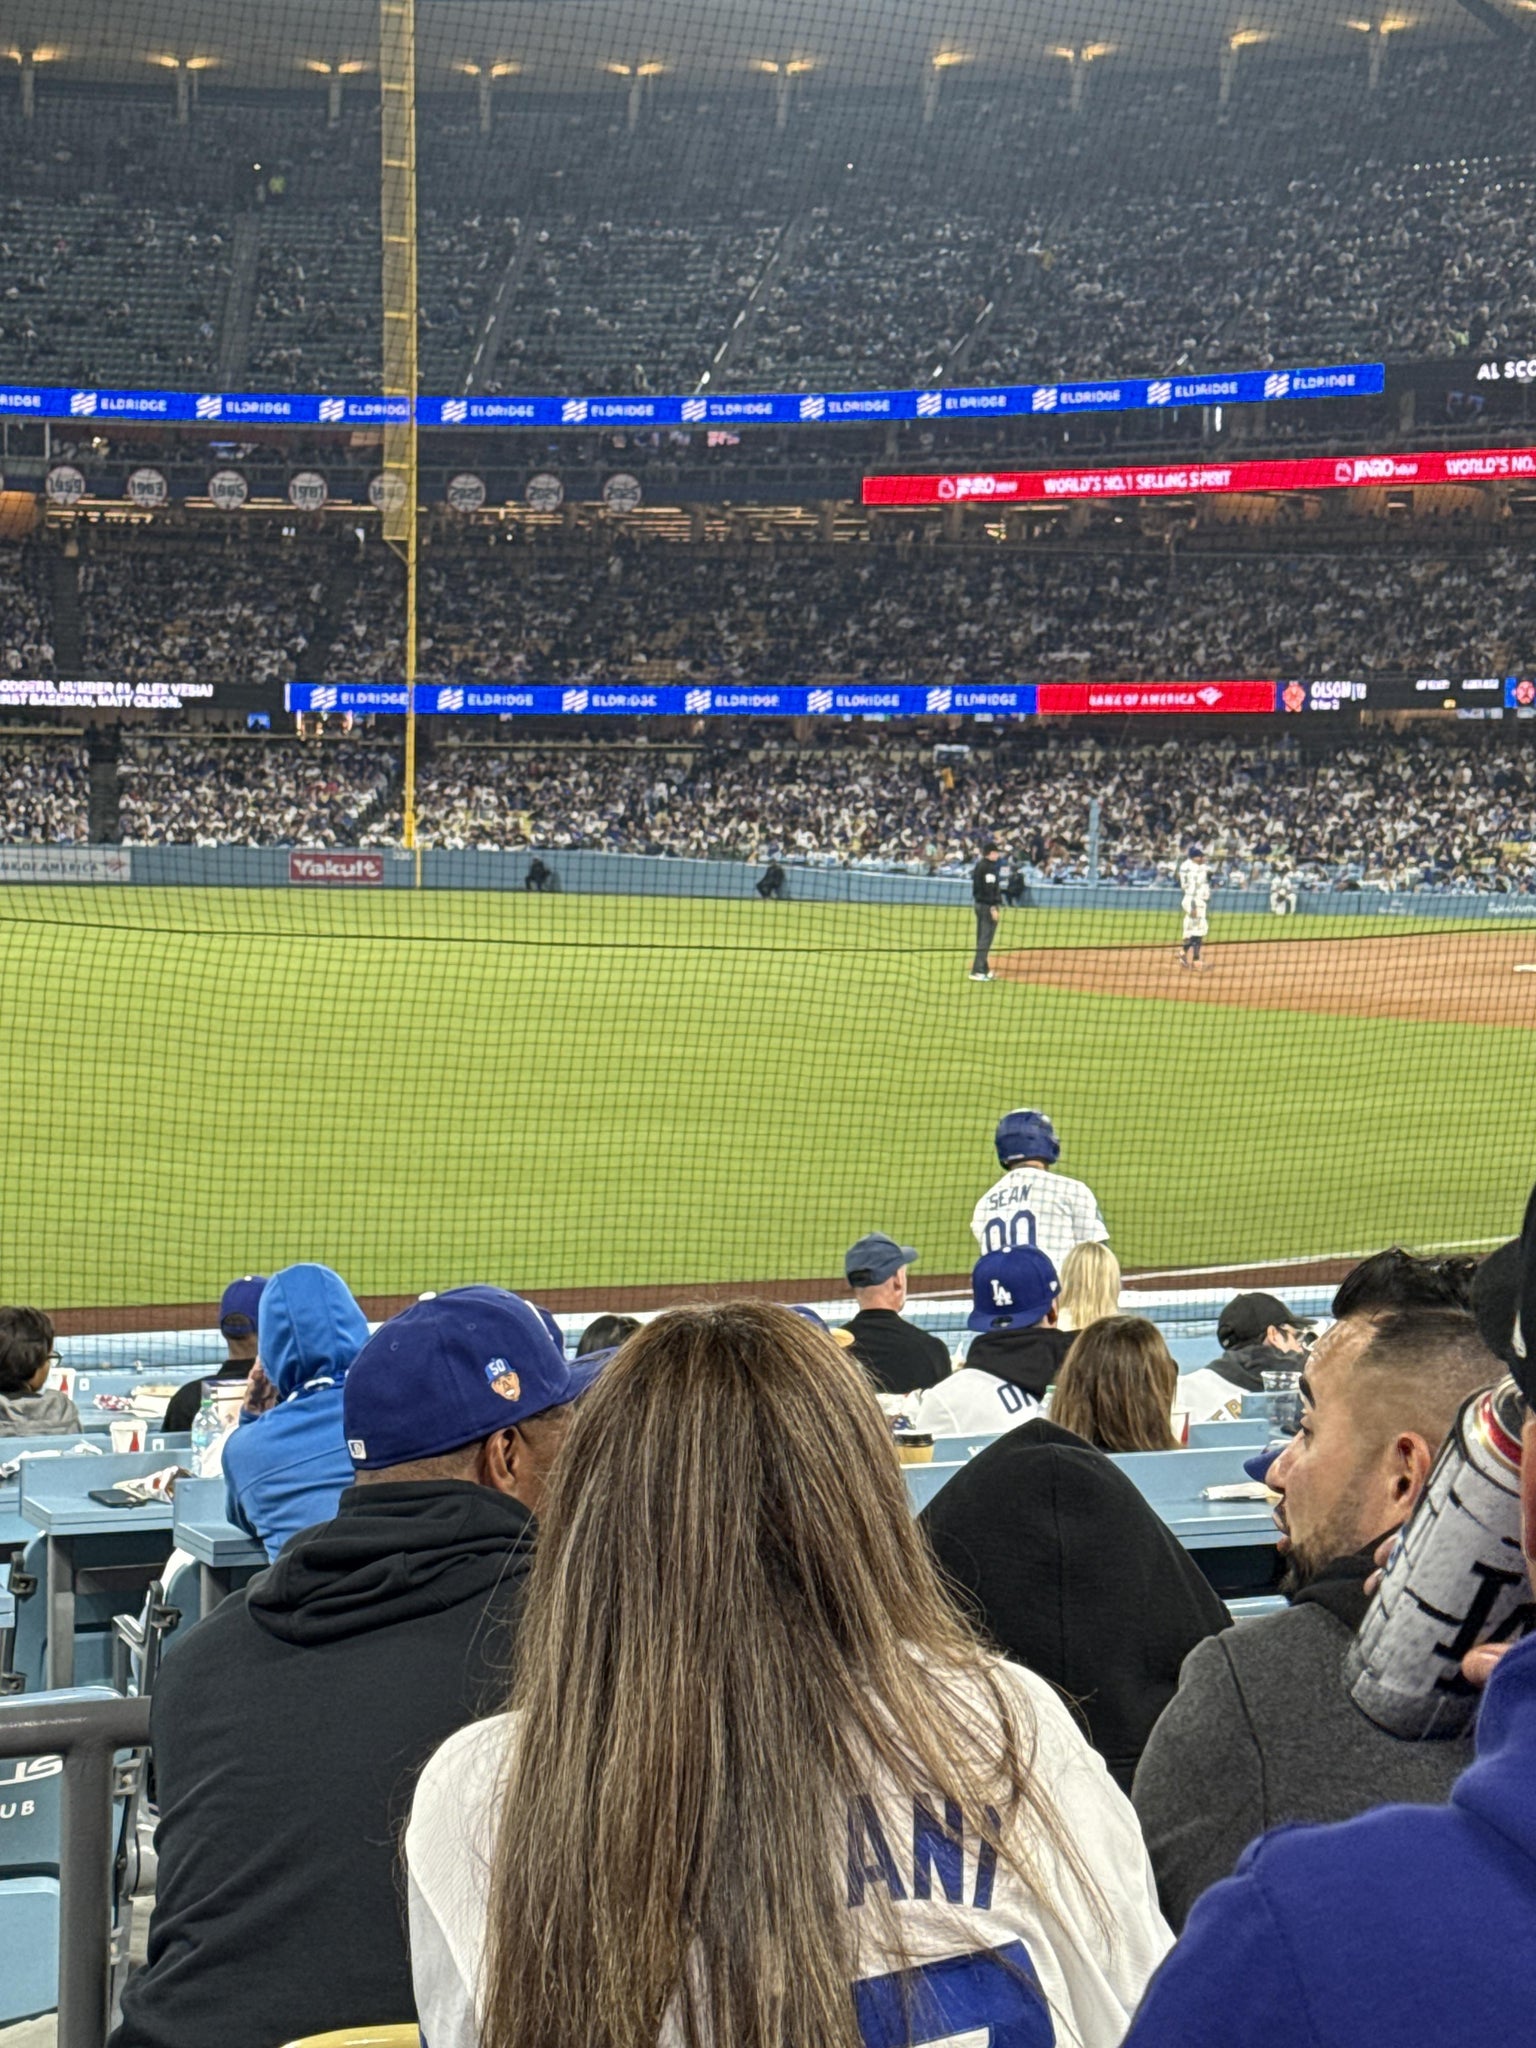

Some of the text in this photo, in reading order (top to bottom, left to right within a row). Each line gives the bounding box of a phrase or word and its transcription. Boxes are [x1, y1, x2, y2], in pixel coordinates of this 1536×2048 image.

[1477, 362, 1500, 380] AL
[1293, 373, 1356, 390] ELDRIDGE
[1060, 389, 1121, 404] ELDRIDGE
[1174, 381, 1238, 398] ELDRIDGE
[101, 397, 167, 411] ELDRIDGE
[225, 401, 291, 415] ELDRIDGE
[827, 399, 891, 413] ELDRIDGE
[945, 394, 1007, 409] ELDRIDGE
[470, 404, 535, 418] ELDRIDGE
[590, 404, 655, 417] ELDRIDGE
[710, 402, 773, 416] ELDRIDGE
[1445, 456, 1509, 476] WORLD'S
[1043, 475, 1102, 494] WORLD'S
[1135, 471, 1188, 490] SELLING
[136, 682, 170, 696] ALEX
[1311, 681, 1349, 698] OLSON
[467, 693, 534, 707] ELDRIDGE
[592, 693, 657, 707] ELDRIDGE
[715, 693, 780, 707] ELDRIDGE
[836, 693, 900, 707] ELDRIDGE
[955, 692, 1018, 706] ELDRIDGE
[1140, 693, 1196, 706] AMERICA
[293, 859, 380, 878] Yakult
[988, 1183, 1033, 1211] SEAN
[990, 1279, 1013, 1307] LA
[488, 1359, 506, 1376] 50
